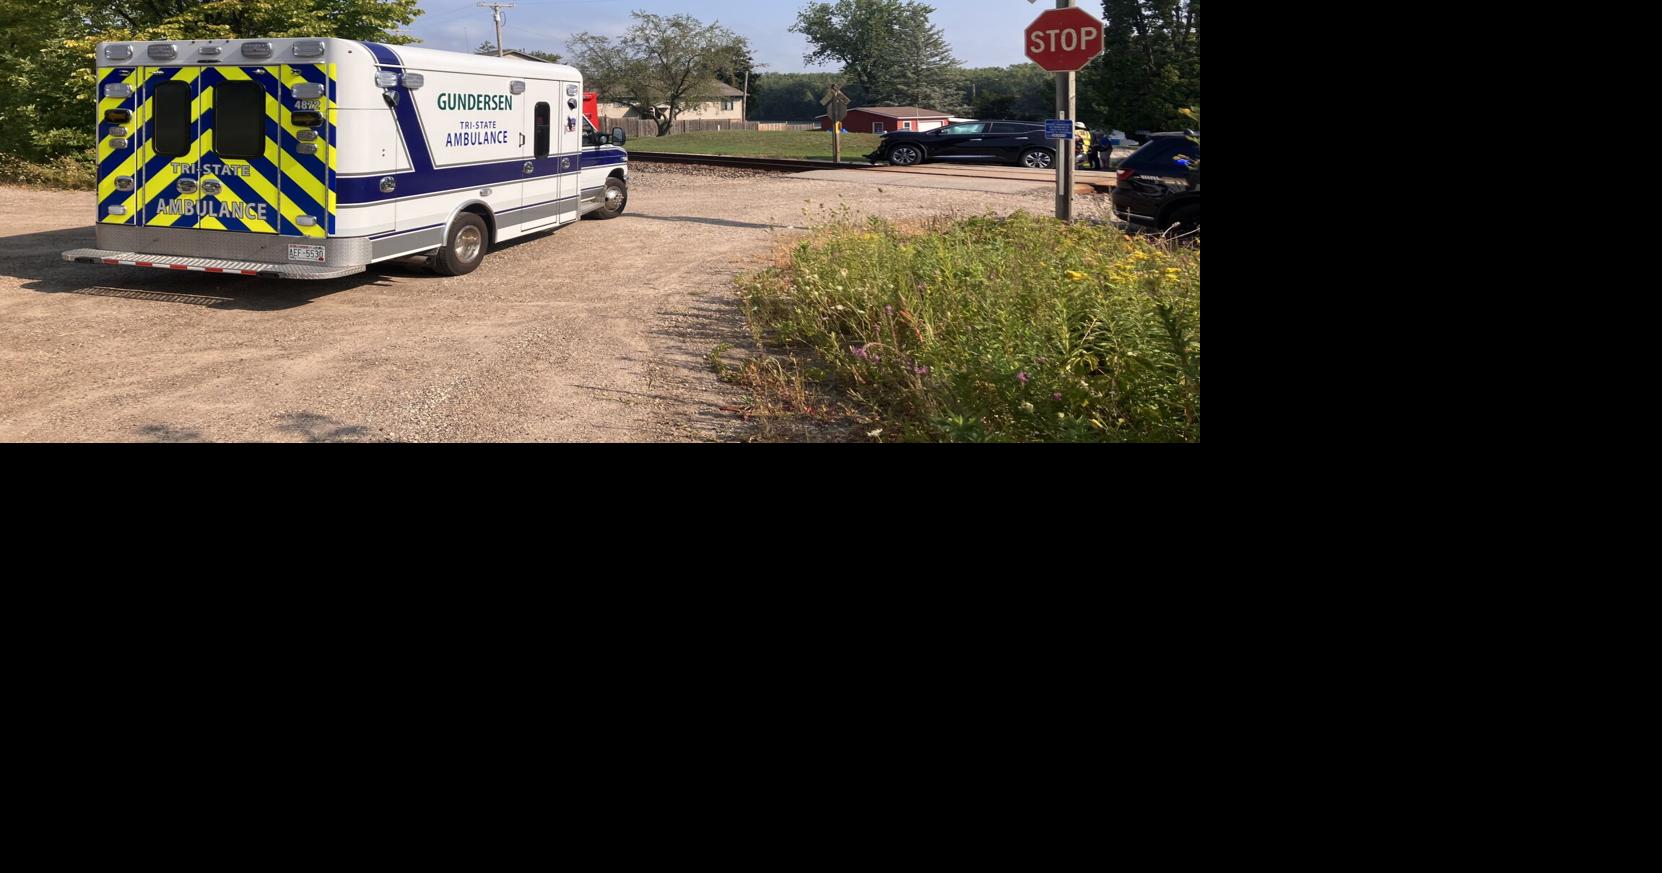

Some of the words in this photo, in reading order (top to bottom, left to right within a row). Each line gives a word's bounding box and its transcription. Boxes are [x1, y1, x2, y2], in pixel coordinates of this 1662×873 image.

[1030, 26, 1097, 53] STOP
[294, 100, 320, 110] 4872
[437, 93, 512, 110] GUNDERSEN
[460, 121, 496, 129] TRI-STATE
[446, 130, 508, 147] AMBULANCE
[171, 162, 250, 176] TRI-STATE
[156, 198, 266, 220] AMBULANCE
